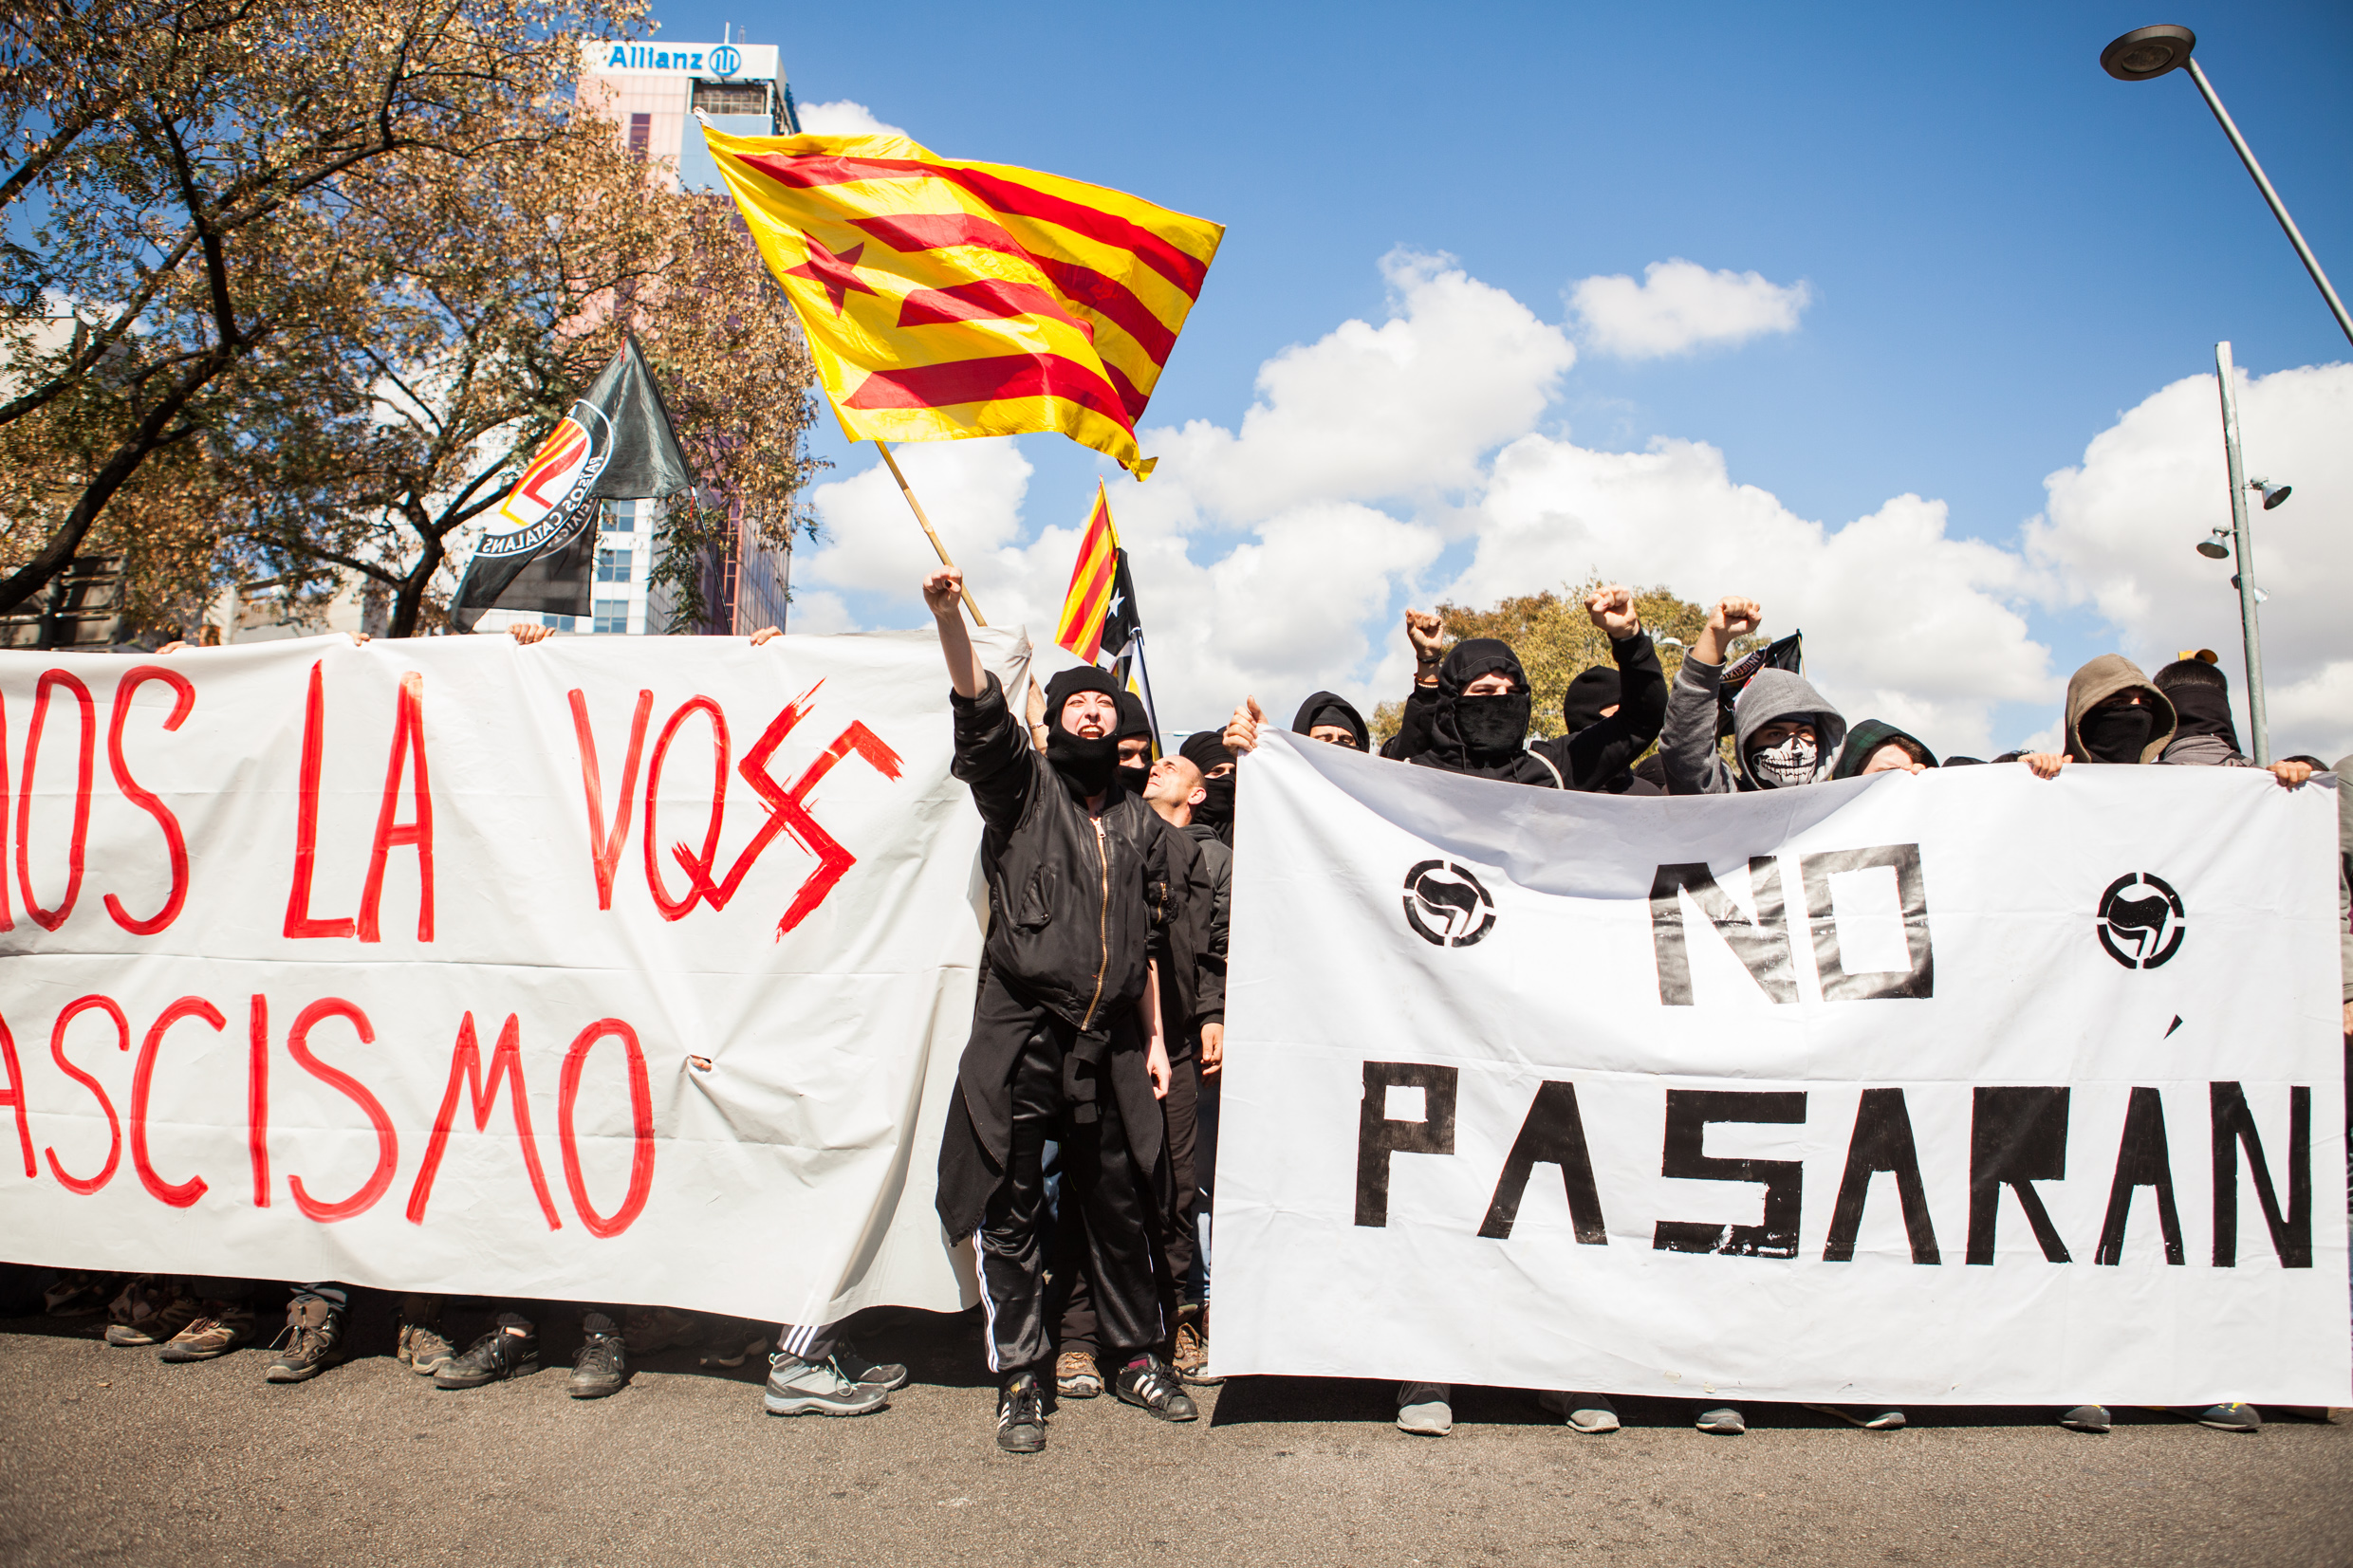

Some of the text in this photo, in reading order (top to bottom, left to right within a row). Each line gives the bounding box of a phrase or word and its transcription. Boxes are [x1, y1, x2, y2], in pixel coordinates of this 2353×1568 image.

[608, 46, 703, 69] Allianz
[284, 659, 434, 943] LA
[1649, 843, 1934, 1006] NO
[1354, 1014, 2314, 1268] PASARÁN
